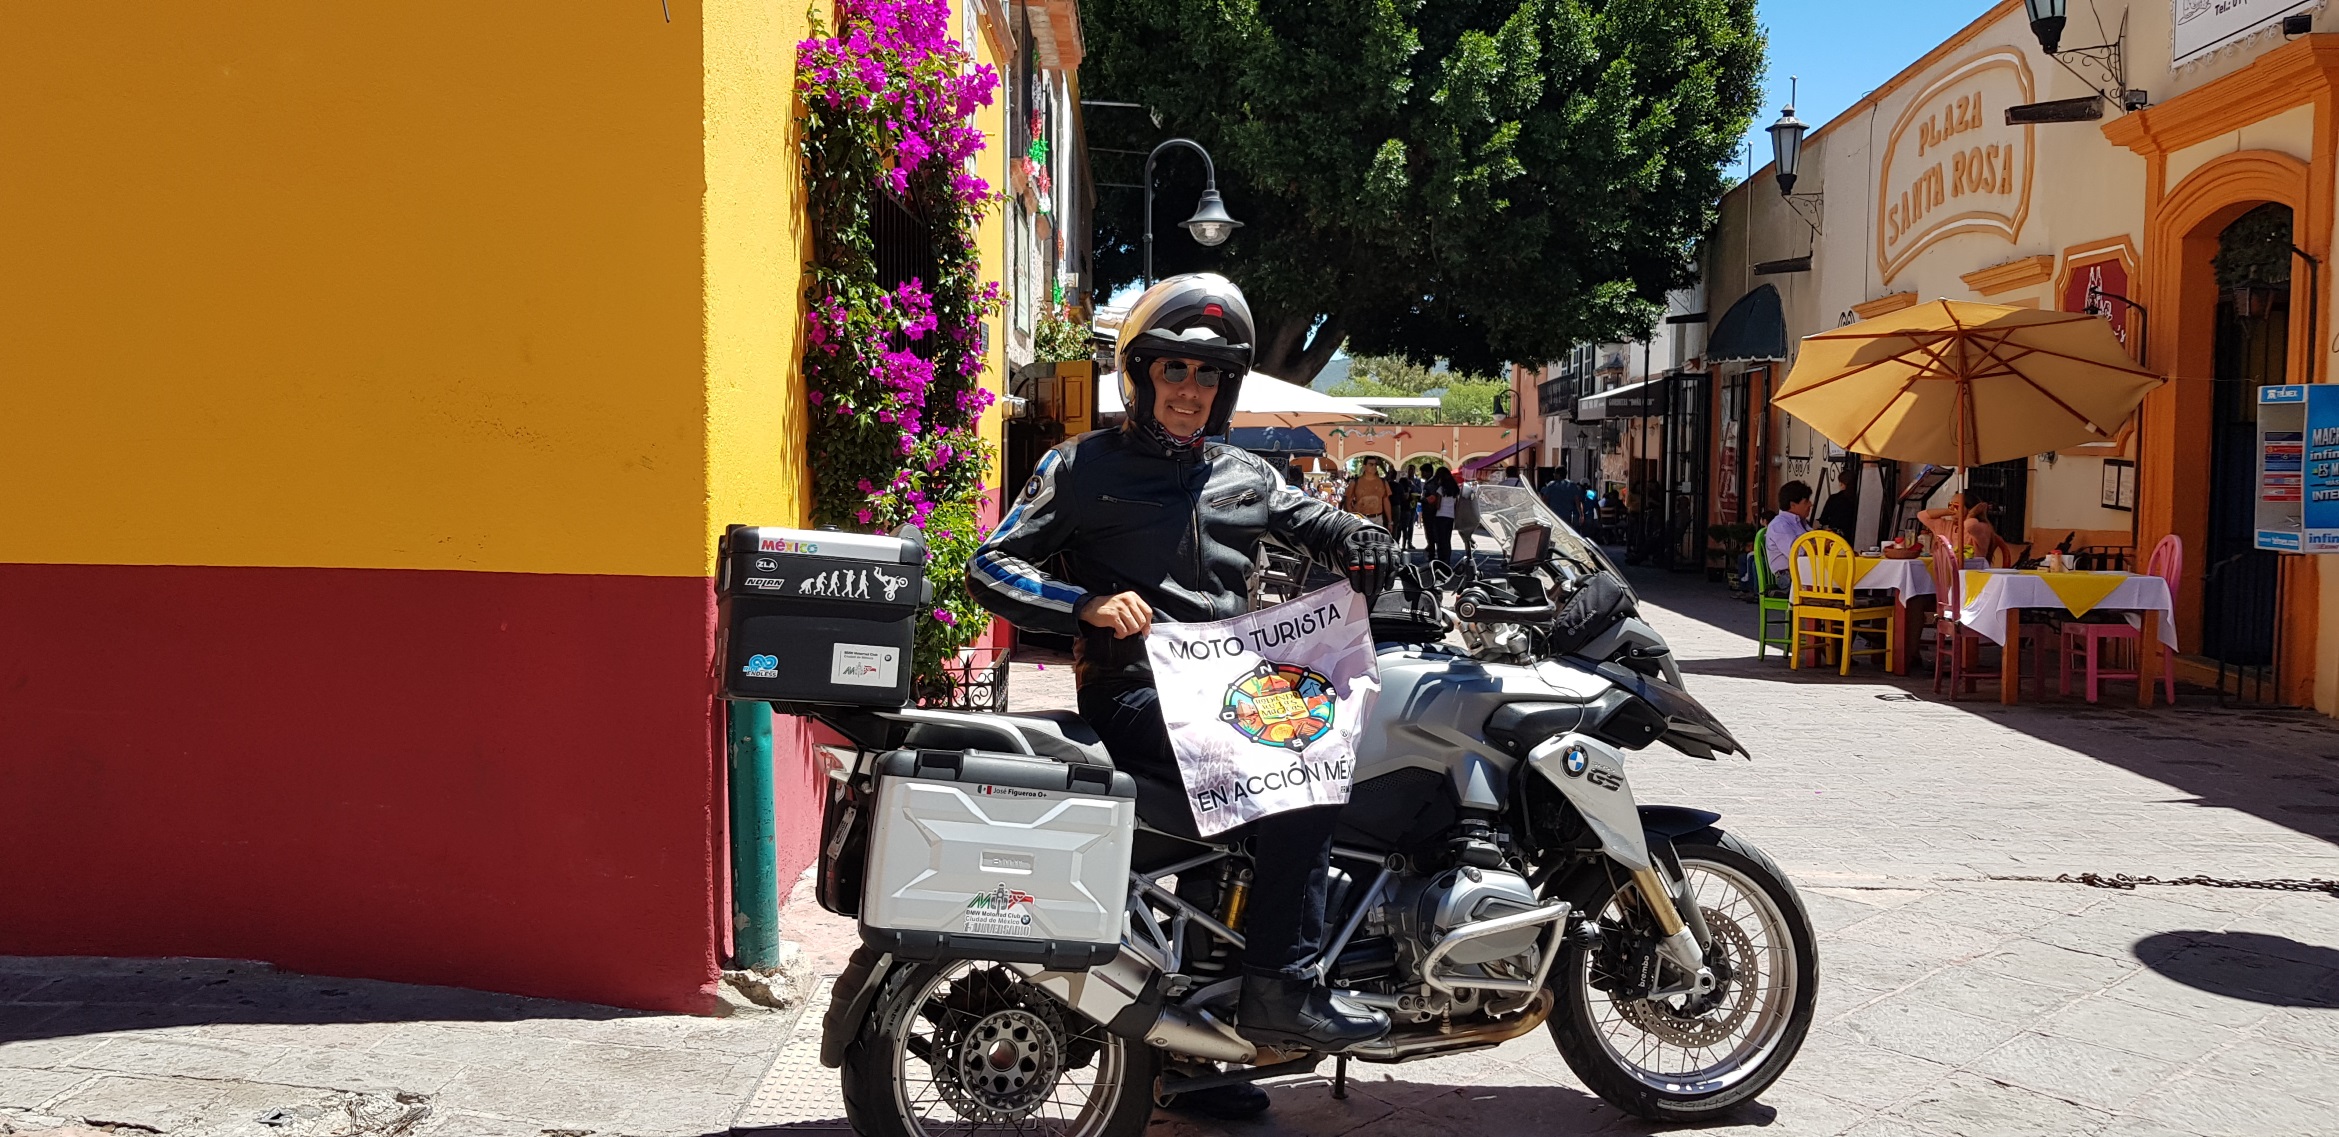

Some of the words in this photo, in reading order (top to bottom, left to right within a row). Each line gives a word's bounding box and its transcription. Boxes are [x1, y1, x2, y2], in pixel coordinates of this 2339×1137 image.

[1918, 91, 1983, 157] PLAZA
[1888, 162, 1945, 247] SANTA
[1951, 144, 2013, 197] ROSA
[2318, 463, 2329, 477] ES
[757, 561, 776, 569] ZLA
[747, 579, 782, 588] NOLAN
[1169, 636, 1245, 660] MOTO
[1249, 603, 1341, 652] TURISTA
[1260, 663, 1272, 674] N
[1326, 687, 1336, 696] E
[1587, 768, 1624, 792] GS
[993, 787, 1007, 795] José
[1008, 788, 1037, 797] Figueroa
[1197, 785, 1228, 812] EN
[1234, 761, 1321, 802] ACCIÓN
[981, 910, 1007, 918] Motorrad
[997, 917, 1020, 925] México
[1637, 955, 1650, 988] brembo
